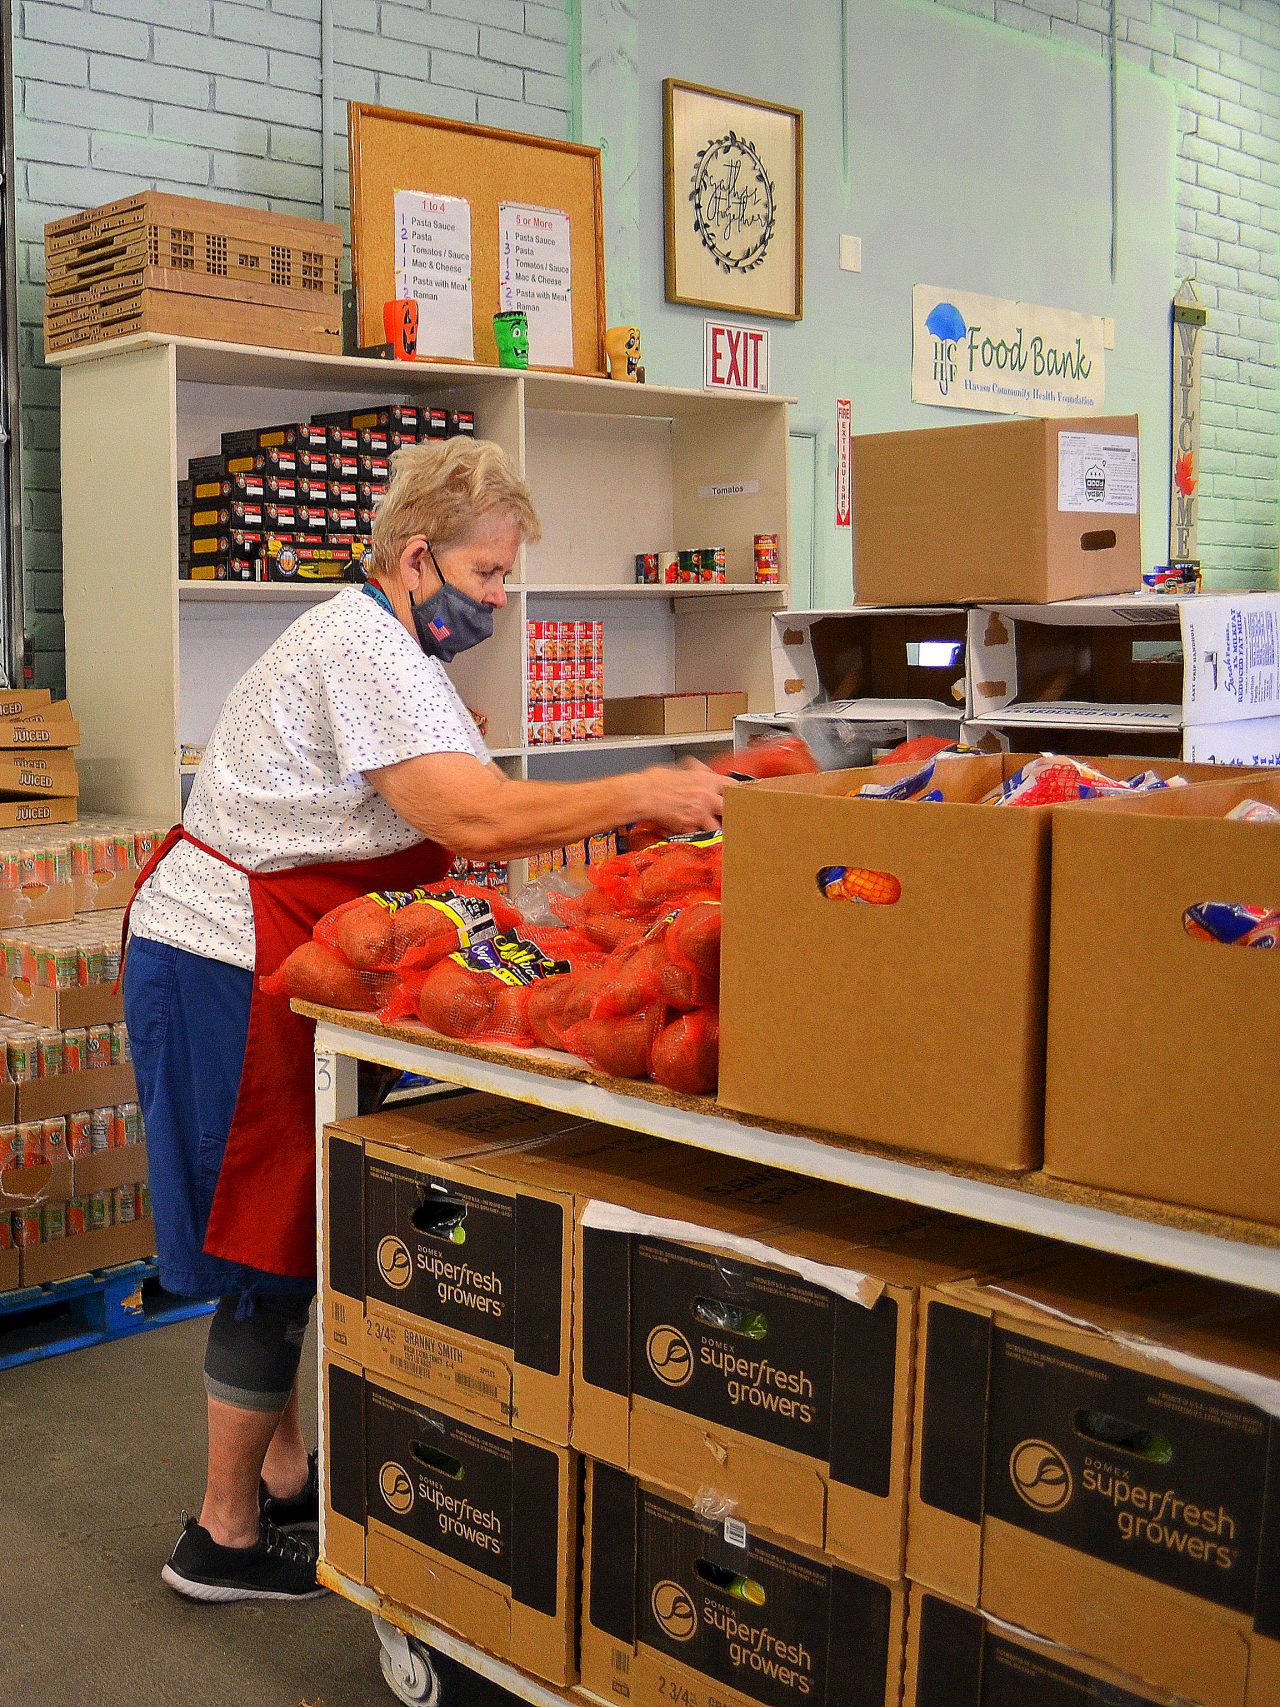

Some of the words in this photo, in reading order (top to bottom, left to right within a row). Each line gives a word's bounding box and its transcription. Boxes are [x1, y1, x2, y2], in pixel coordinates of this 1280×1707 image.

[430, 201, 438, 211] to
[439, 203, 446, 213] 4
[412, 216, 432, 228] Pasta
[433, 220, 456, 232] Sauce
[516, 214, 521, 225] 5
[522, 218, 532, 227] or
[533, 218, 553, 230] More
[401, 228, 408, 240] 2
[412, 230, 432, 242] Pasta
[515, 232, 534, 243] Pasta
[535, 235, 556, 246] Sauce
[448, 249, 470, 261] Sauce
[504, 243, 510, 255] 3
[515, 245, 535, 256] Pasta
[412, 258, 427, 270] Mac
[428, 260, 434, 270] &
[435, 262, 462, 274] Cheese
[549, 263, 570, 274] Sauce
[504, 271, 510, 280] 2
[515, 272, 530, 282] Mac
[530, 274, 536, 282] &
[537, 274, 562, 286] Cheese
[412, 276, 434, 288] Pasta
[434, 279, 449, 289] with
[450, 280, 468, 292] Meat
[413, 290, 438, 301] Raman
[506, 287, 512, 299] 2
[516, 288, 536, 299] Pasta
[536, 290, 551, 300] with
[551, 292, 567, 302] Meat
[516, 302, 540, 312] Raman
[712, 328, 764, 388] EXIT
[967, 326, 1028, 372] Food
[1030, 336, 1092, 380] Bank
[992, 383, 1031, 401] Community
[1032, 388, 1056, 402] Health
[1057, 391, 1094, 407] Foundation
[838, 408, 850, 420] FIRE
[712, 484, 744, 496] Tomatos
[1023, 708, 1094, 718] REDUCED
[13, 729, 50, 743] JUICED
[19, 772, 54, 788] JUICED
[16, 806, 50, 821] JUICED
[86, 1038, 100, 1051] V8
[318, 1058, 331, 1090] 3
[49, 1131, 62, 1145] V8
[418, 1244, 443, 1258] DOMEX
[417, 1253, 502, 1295] superfresh
[438, 1280, 503, 1317] growers
[366, 1320, 372, 1336] 2
[375, 1322, 390, 1344] 3/4
[404, 1329, 436, 1353] GRANNY
[438, 1342, 464, 1364] SMITH
[701, 1336, 734, 1353] DOMEX
[700, 1346, 812, 1398] superfresh
[728, 1380, 812, 1424] growers
[1084, 1456, 1130, 1479] DOMEX
[419, 1474, 444, 1491] DOMEX
[418, 1483, 502, 1534] superfresh
[1082, 1468, 1236, 1540] superfresh
[438, 1513, 501, 1555] growers
[1118, 1510, 1233, 1570] growers
[704, 1597, 736, 1616] DOMEX
[703, 1606, 812, 1671] superfresh
[729, 1642, 810, 1694] growers
[658, 1676, 666, 1695] 2
[670, 1683, 688, 1706] 3/4
